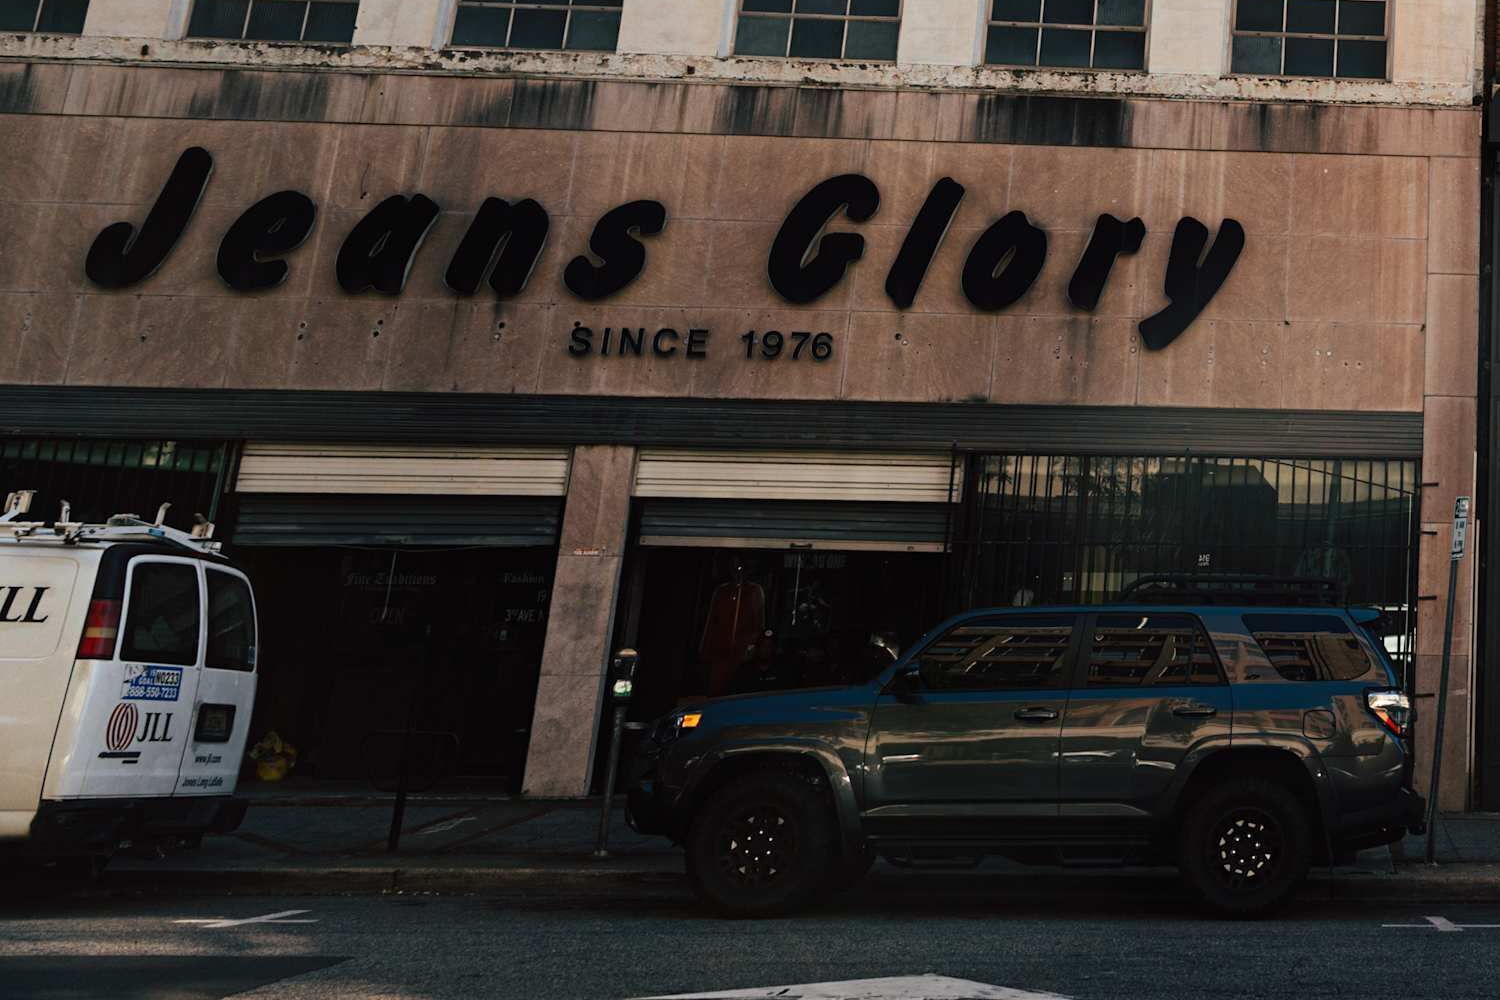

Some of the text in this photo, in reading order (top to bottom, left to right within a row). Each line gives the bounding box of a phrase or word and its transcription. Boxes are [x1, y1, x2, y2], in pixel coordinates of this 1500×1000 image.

[85, 146, 1245, 351] Jeans Glory
[568, 325, 835, 361] SINCE 1976
[0, 586, 50, 623] LL
[137, 712, 174, 742] JLL
